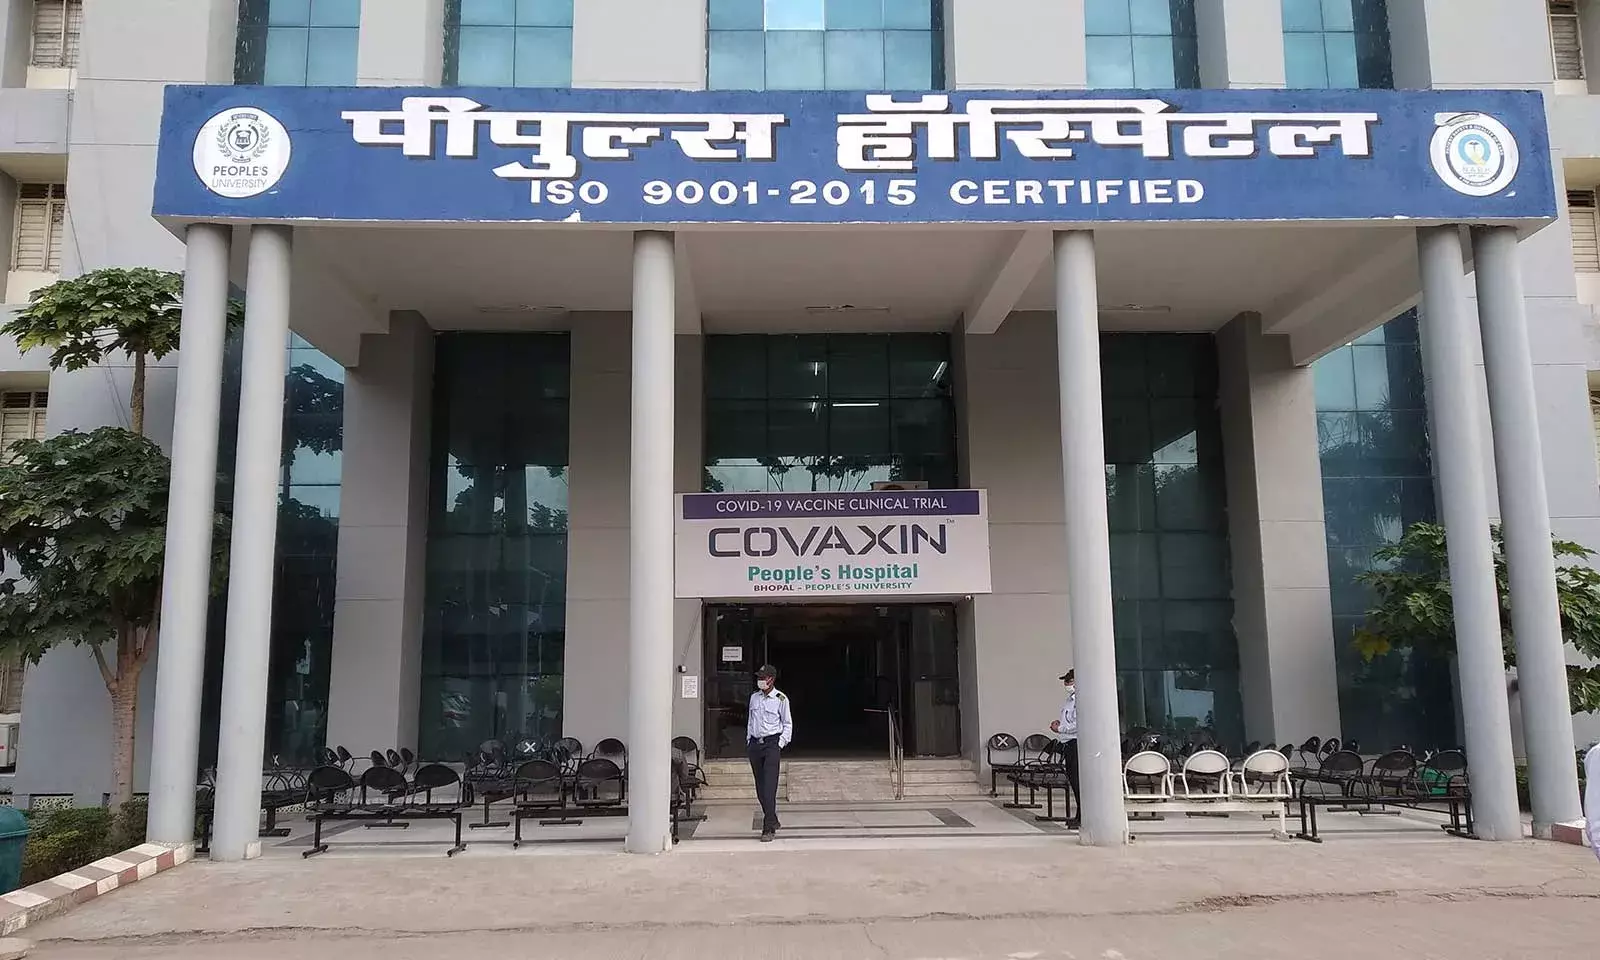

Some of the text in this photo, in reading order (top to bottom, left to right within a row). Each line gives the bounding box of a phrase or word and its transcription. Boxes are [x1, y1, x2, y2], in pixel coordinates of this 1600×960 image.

[341, 96, 786, 178] पीपुल्स
[836, 94, 1379, 170] हॉस्पिटल
[213, 165, 268, 176] PEOPLE'S
[211, 178, 267, 188] UNIVERSITY
[530, 179, 609, 205] ISO
[949, 179, 1205, 205] CERTIFIED
[716, 497, 948, 512] COVID-19 VACCINE CLINICAL TRIAL
[708, 523, 947, 558] COVAXIN
[838, 563, 918, 583] Hospital
[753, 584, 795, 592] BHOPAL
[805, 583, 851, 591] PEOPLE'S
[854, 582, 912, 590] UNIVERSITY
